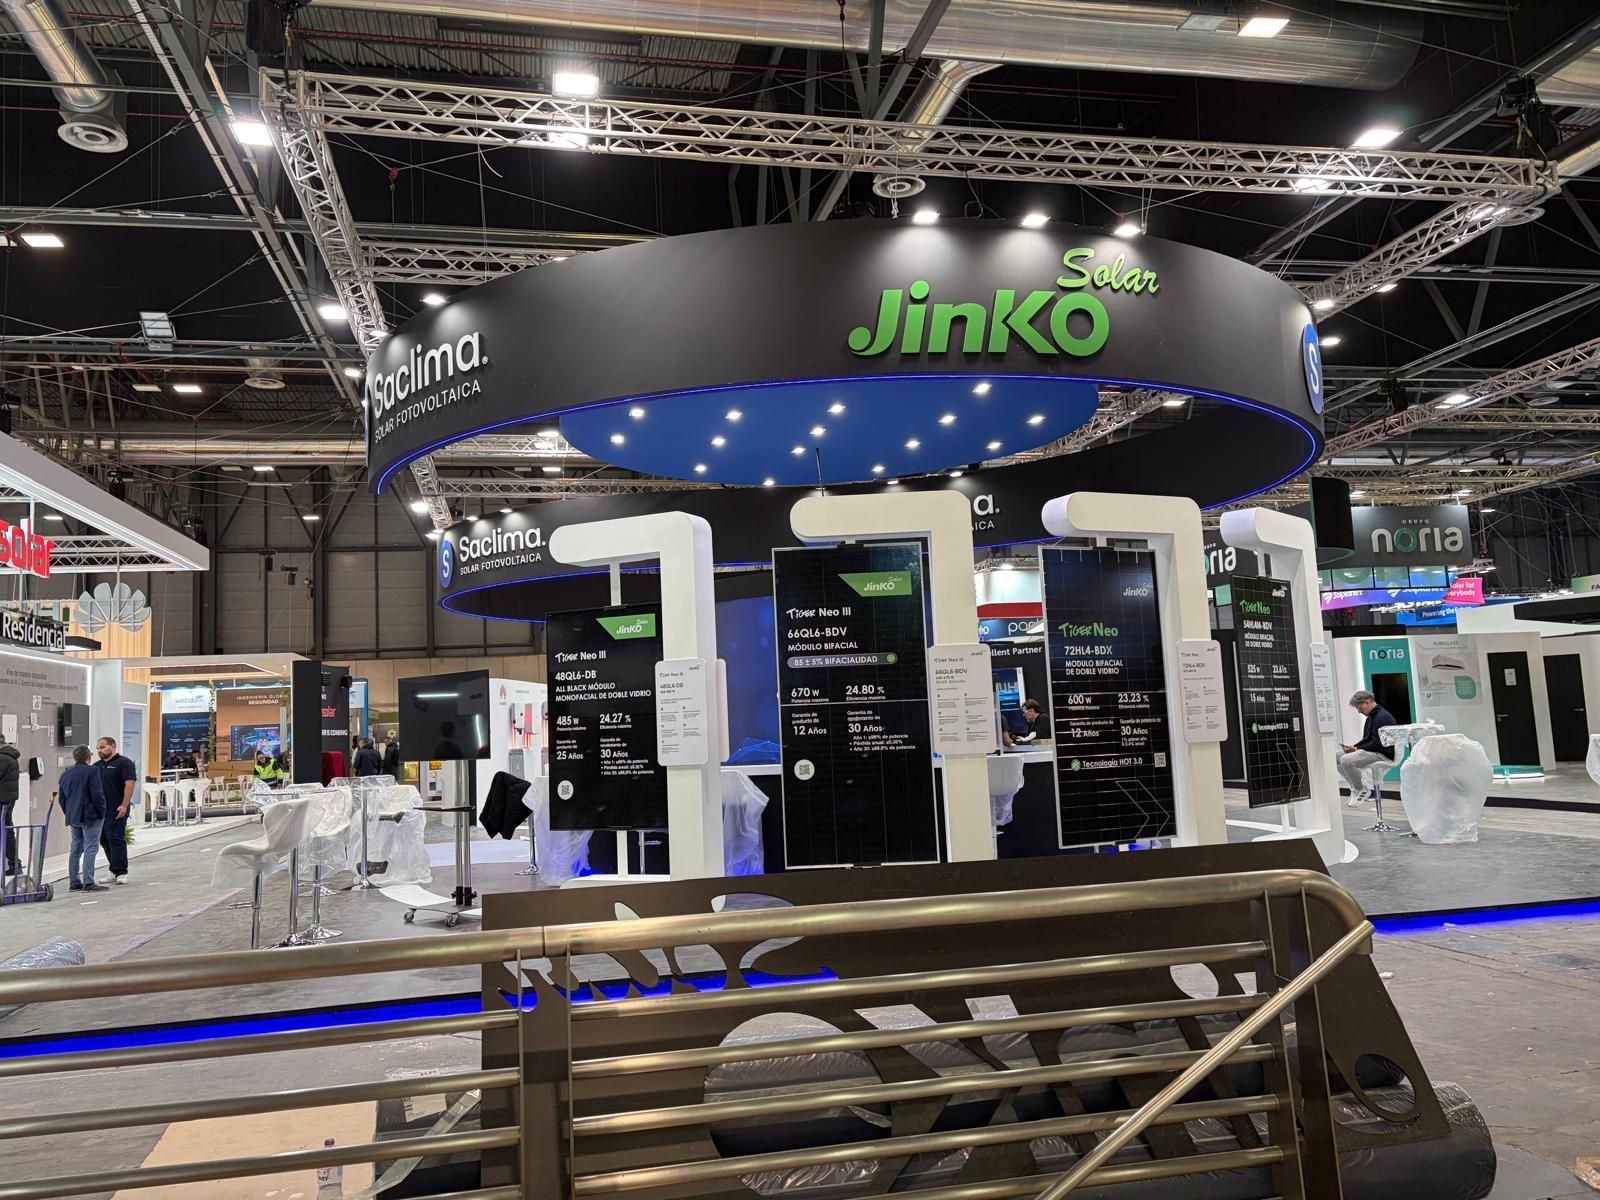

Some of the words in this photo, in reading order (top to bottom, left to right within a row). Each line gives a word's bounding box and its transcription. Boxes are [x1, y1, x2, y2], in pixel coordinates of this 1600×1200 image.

[1057, 248, 1159, 294] Solar
[375, 418, 394, 443] SOLAR
[396, 379, 481, 427] FOTOVOLTAICA
[1371, 526, 1464, 553] noria
[460, 564, 480, 575] SOLAR
[481, 552, 542, 570] FOTOVOLTAICA
[818, 608, 840, 617] Neo
[842, 606, 852, 616] III
[2, 611, 66, 649] Residencial
[787, 626, 847, 639] 66QL6-BDV
[1093, 622, 1119, 637] Neo
[787, 643, 822, 652] MÓDULO
[824, 642, 859, 650] BIFACIAL
[1012, 646, 1043, 655] Partner
[1064, 645, 1113, 656] 72HL4-BDX
[580, 651, 597, 660] Neo
[598, 650, 607, 659] III
[825, 655, 878, 665] BIFACIALIDAD
[1095, 658, 1124, 667] BIFACIAL
[554, 670, 597, 681] 48QL6-DB
[1066, 668, 1074, 676] DE
[1097, 667, 1120, 675] VIDRIO
[566, 684, 587, 692] BLACK
[587, 682, 616, 691] MÓDULO
[791, 687, 811, 697] 670
[845, 685, 875, 695] 24.80
[877, 686, 885, 694] %
[555, 692, 598, 702] MONOFACIAL
[598, 692, 608, 700] DE
[608, 691, 628, 699] DOBLE
[629, 689, 651, 697] VIDRIO
[1068, 694, 1085, 705] 600
[1118, 693, 1141, 703] 23.23
[556, 716, 572, 726] 485
[599, 713, 623, 724] 24.27
[793, 726, 806, 736] 12
[807, 727, 828, 735] Años
[848, 723, 861, 733] 30
[863, 725, 883, 733] Años
[1071, 728, 1082, 738] 12
[1120, 726, 1132, 736] 30
[556, 751, 567, 760] 25
[567, 752, 584, 760] Años
[600, 749, 611, 758] 30
[612, 750, 628, 758] Años
